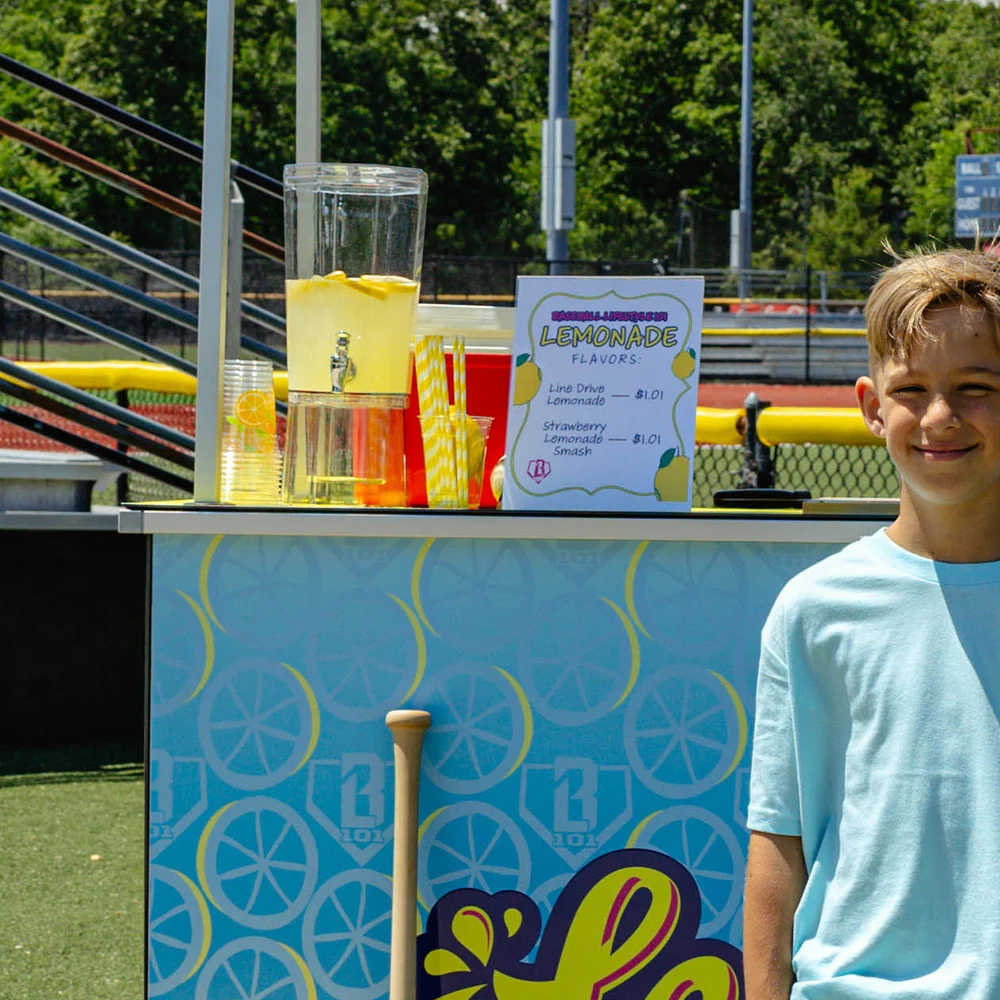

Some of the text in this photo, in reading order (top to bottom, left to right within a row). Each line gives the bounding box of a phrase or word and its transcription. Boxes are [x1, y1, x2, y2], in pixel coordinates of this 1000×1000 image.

[961, 162, 982, 175] BALL
[540, 324, 678, 349] LEMONADE
[572, 353, 642, 365] FLAVORS:
[549, 383, 605, 394] Line Drive
[547, 396, 606, 406] Lemonade
[634, 389, 664, 401] $1.01
[542, 421, 607, 434] Strawberry
[544, 433, 661, 445] Lemonade $1.01
[553, 445, 592, 456] Smash
